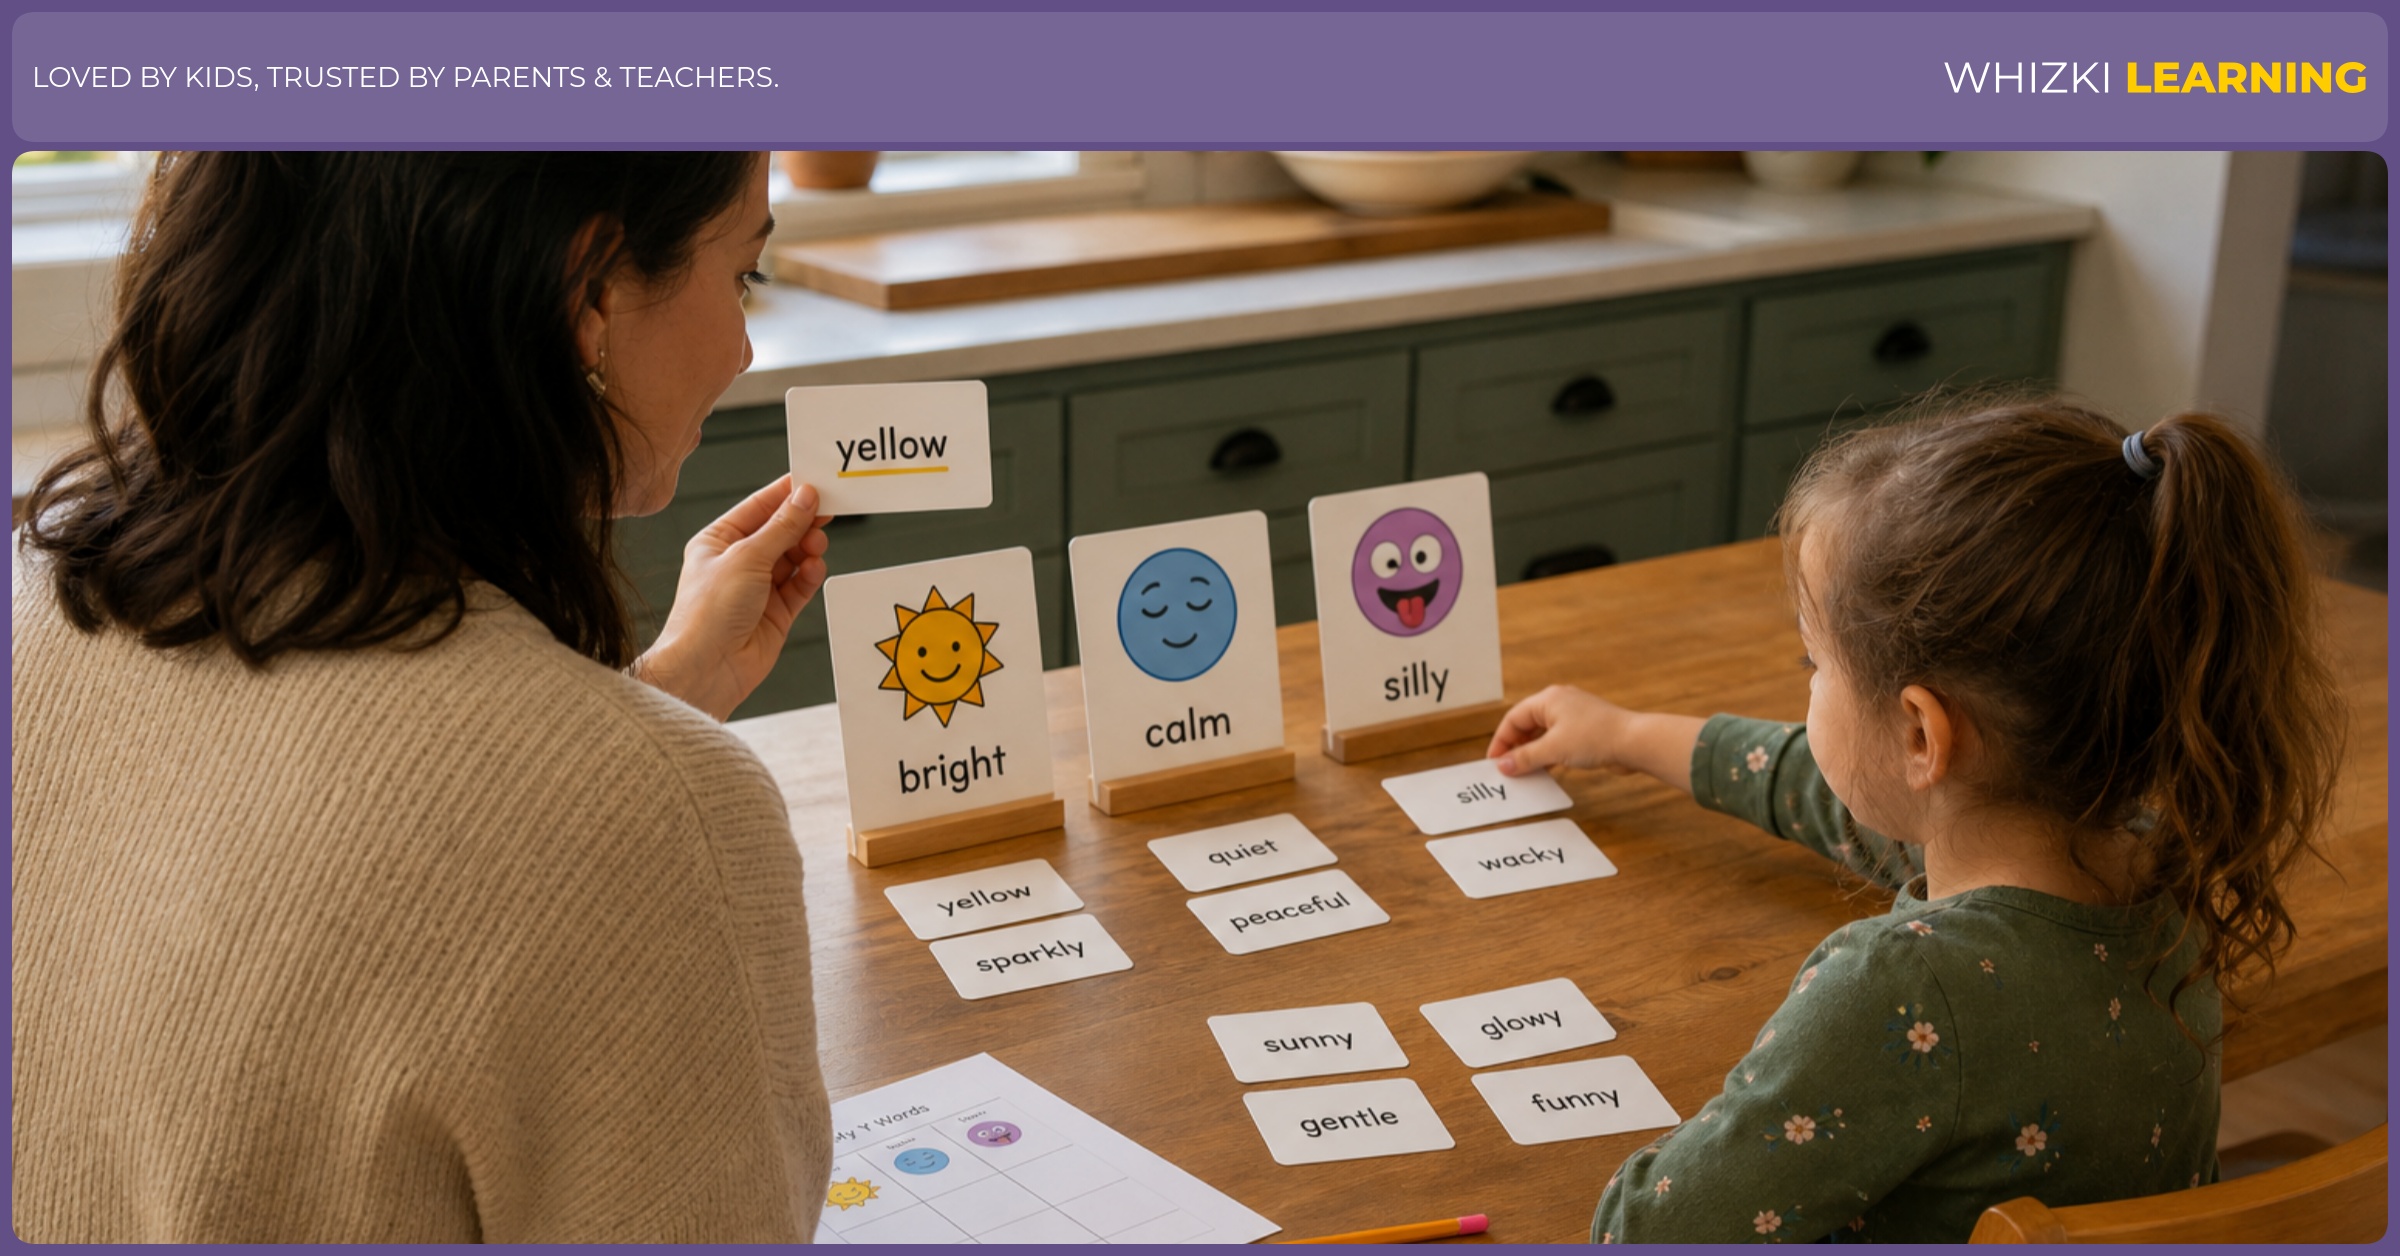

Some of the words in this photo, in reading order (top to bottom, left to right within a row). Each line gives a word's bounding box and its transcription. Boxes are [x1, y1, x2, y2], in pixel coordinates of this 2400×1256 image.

[836, 427, 946, 472] yellow
[1384, 660, 1449, 703] silly
[1145, 706, 1231, 748] calm
[898, 745, 1006, 795] bright
[1456, 782, 1508, 804] silly
[1209, 840, 1277, 865] quiet
[1478, 847, 1565, 871] wacky
[938, 887, 1030, 916] yellow
[1230, 892, 1350, 933] peaceful
[977, 941, 1083, 973] sparkly
[1480, 1008, 1562, 1041] glowy
[1263, 1030, 1353, 1054] sunny
[1531, 1088, 1620, 1114] funny
[857, 1123, 871, 1132] Y
[873, 1105, 930, 1127] Words
[1300, 1106, 1399, 1138] gentle
